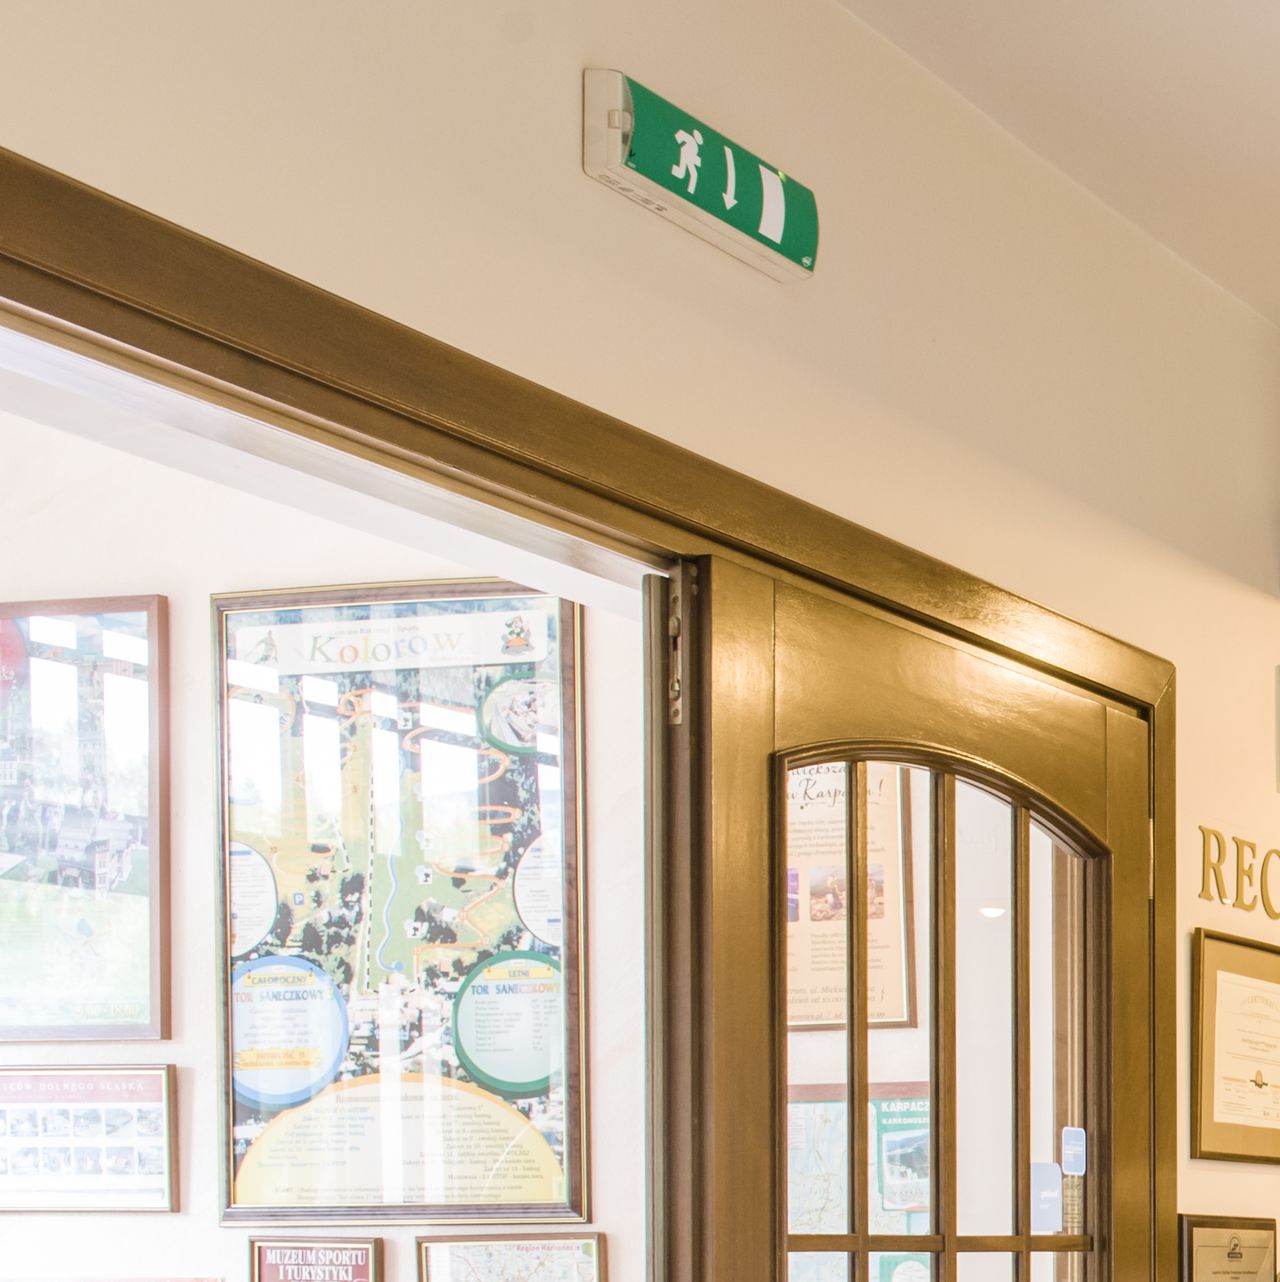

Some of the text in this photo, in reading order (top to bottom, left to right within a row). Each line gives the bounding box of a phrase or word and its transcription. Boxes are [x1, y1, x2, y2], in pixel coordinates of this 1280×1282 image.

[310, 626, 465, 664] Kolorow
[470, 984, 490, 996] TOR
[266, 1249, 366, 1265] MUZEUM SPORTU
[285, 1265, 354, 1281] TURYSTYKI
